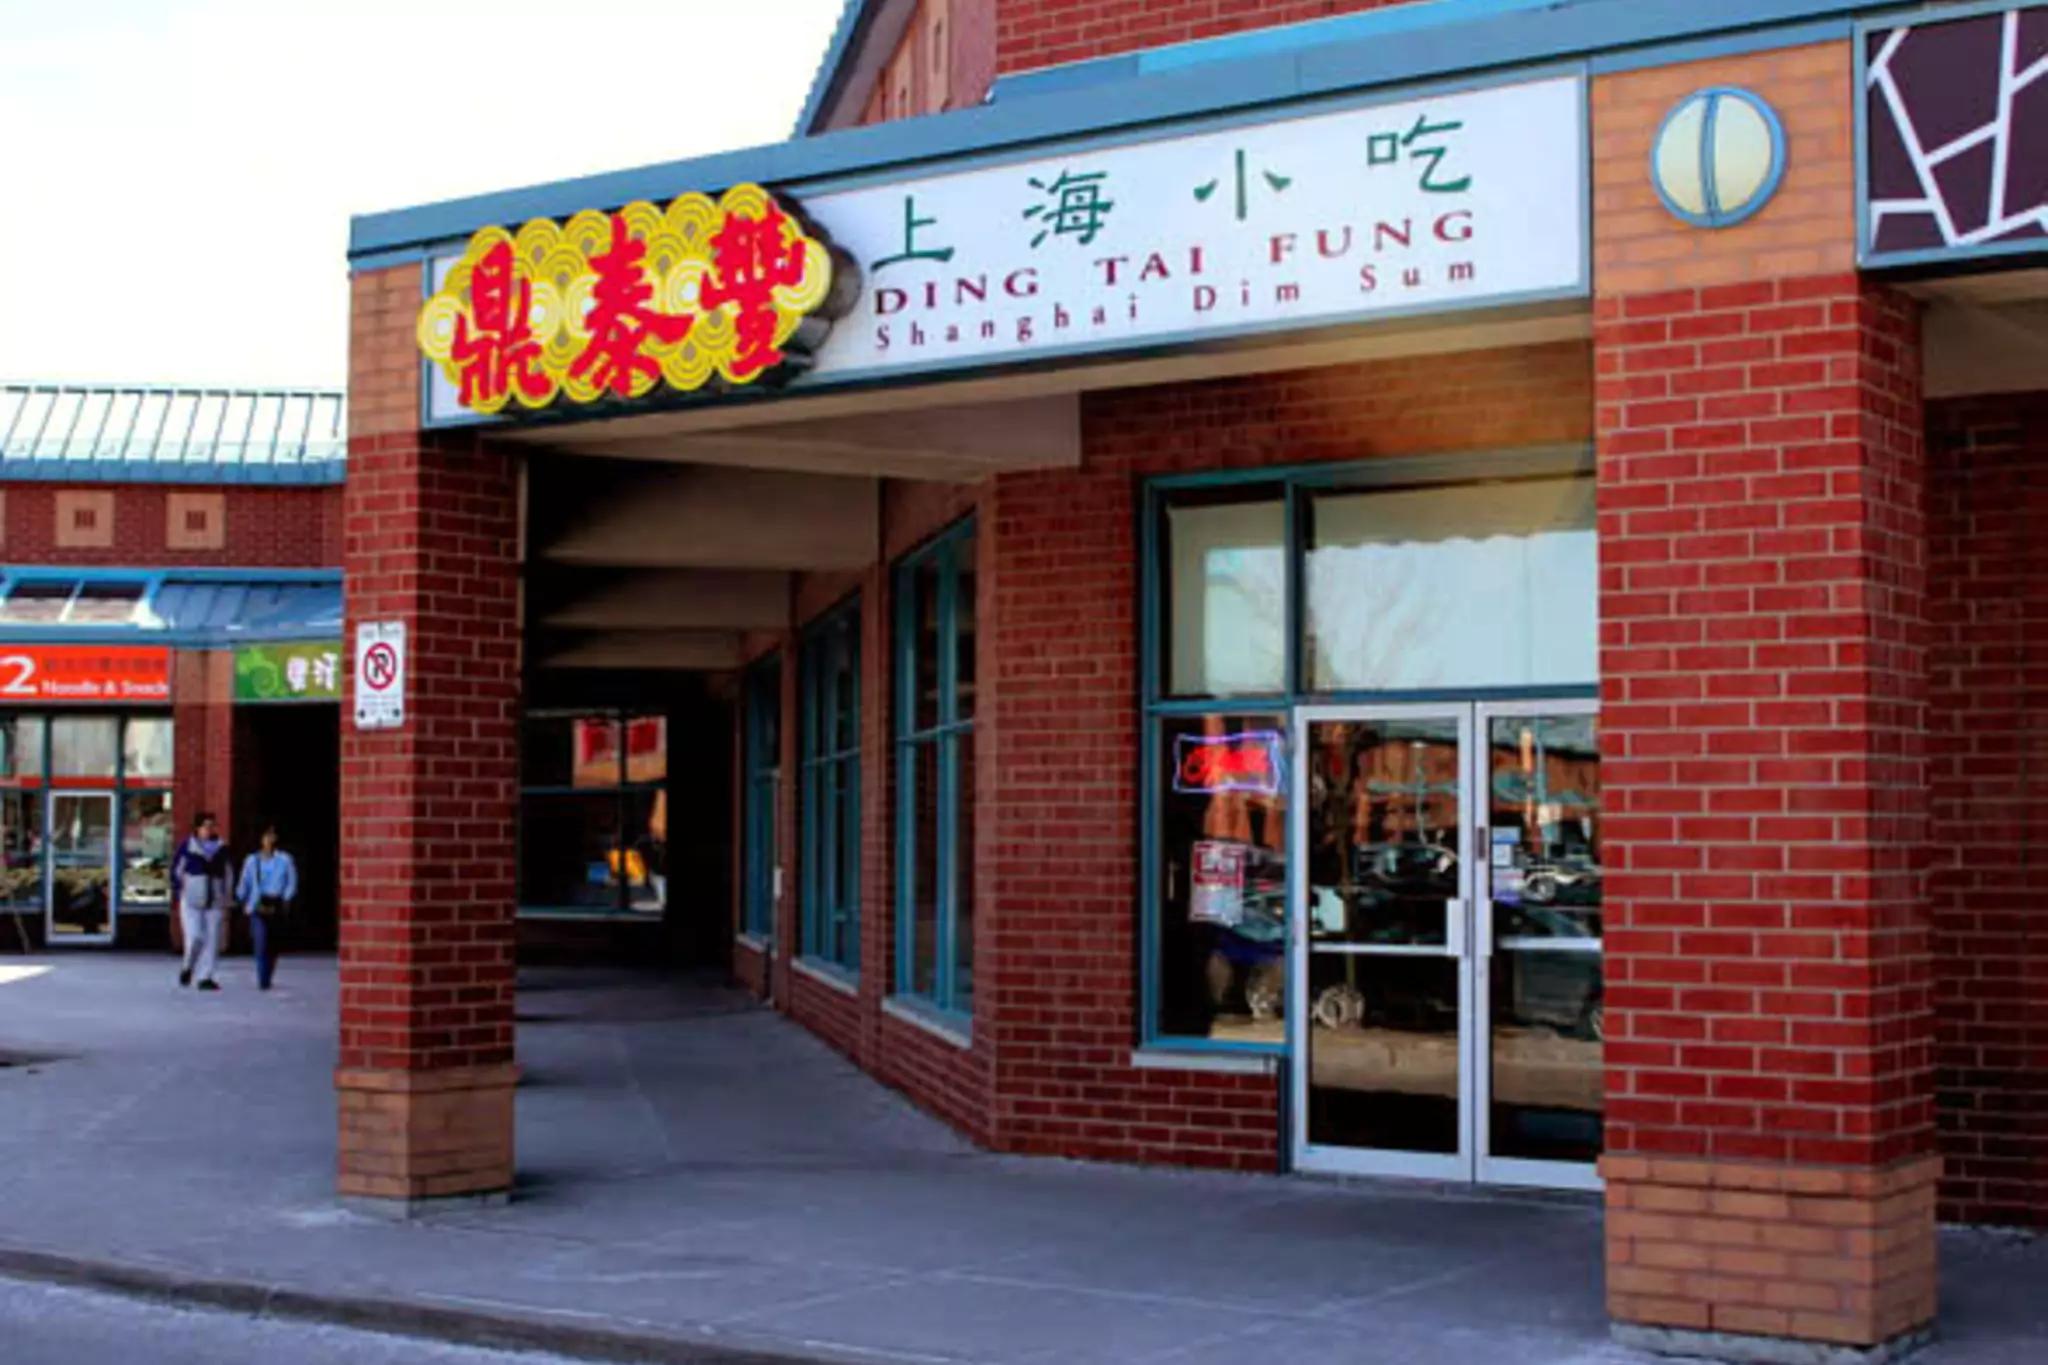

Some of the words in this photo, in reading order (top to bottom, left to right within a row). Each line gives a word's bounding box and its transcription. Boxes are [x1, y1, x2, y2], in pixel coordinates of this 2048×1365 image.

[870, 114, 1472, 271] 上海小吃
[874, 268, 1039, 315] DING
[1093, 246, 1204, 286] TAI
[1268, 210, 1474, 264] FUNG
[876, 294, 1138, 350] Shanghai
[1193, 282, 1300, 312] Dim
[1359, 261, 1475, 293] Sum
